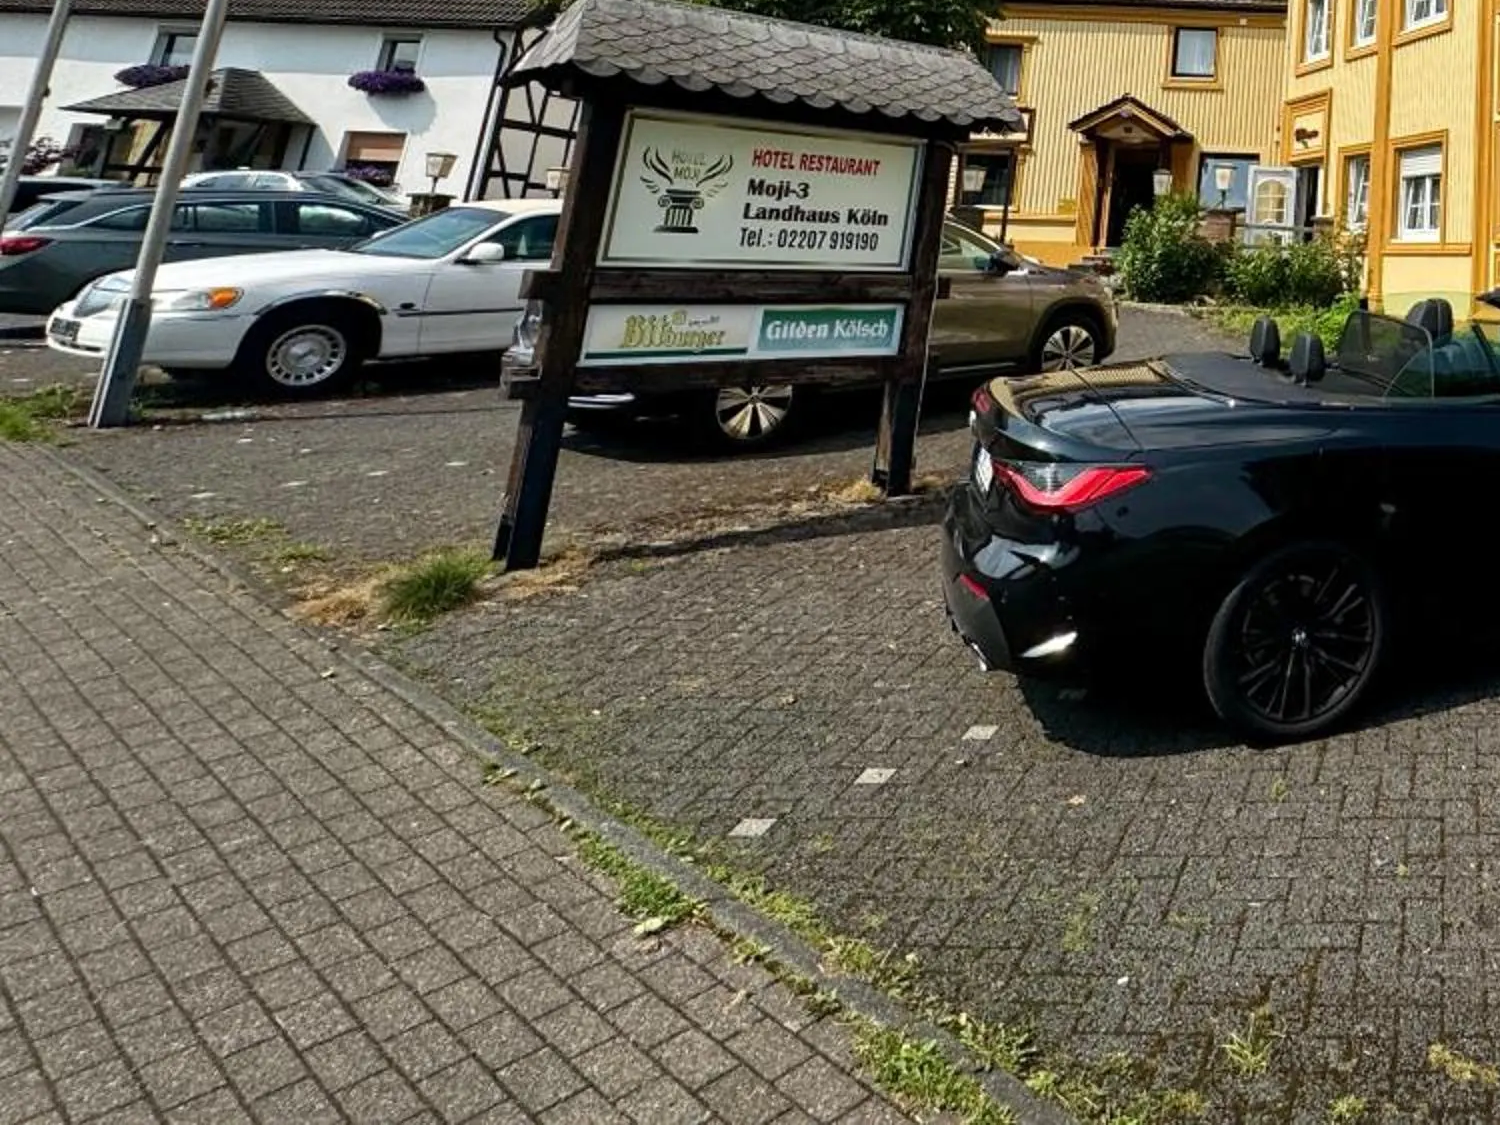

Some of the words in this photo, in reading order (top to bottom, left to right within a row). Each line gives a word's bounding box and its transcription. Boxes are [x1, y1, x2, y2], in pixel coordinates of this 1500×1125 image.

[752, 148, 795, 169] HOTEL
[800, 153, 881, 176] RESTAURANT
[747, 179, 810, 201] Moji-3
[743, 202, 841, 224] Landhaus
[847, 208, 889, 226] Köln
[740, 227, 773, 247] Tel.:
[777, 228, 827, 249] 02207
[829, 231, 879, 251] 919190
[766, 320, 829, 340] Gilden
[833, 319, 888, 338] Kölsch
